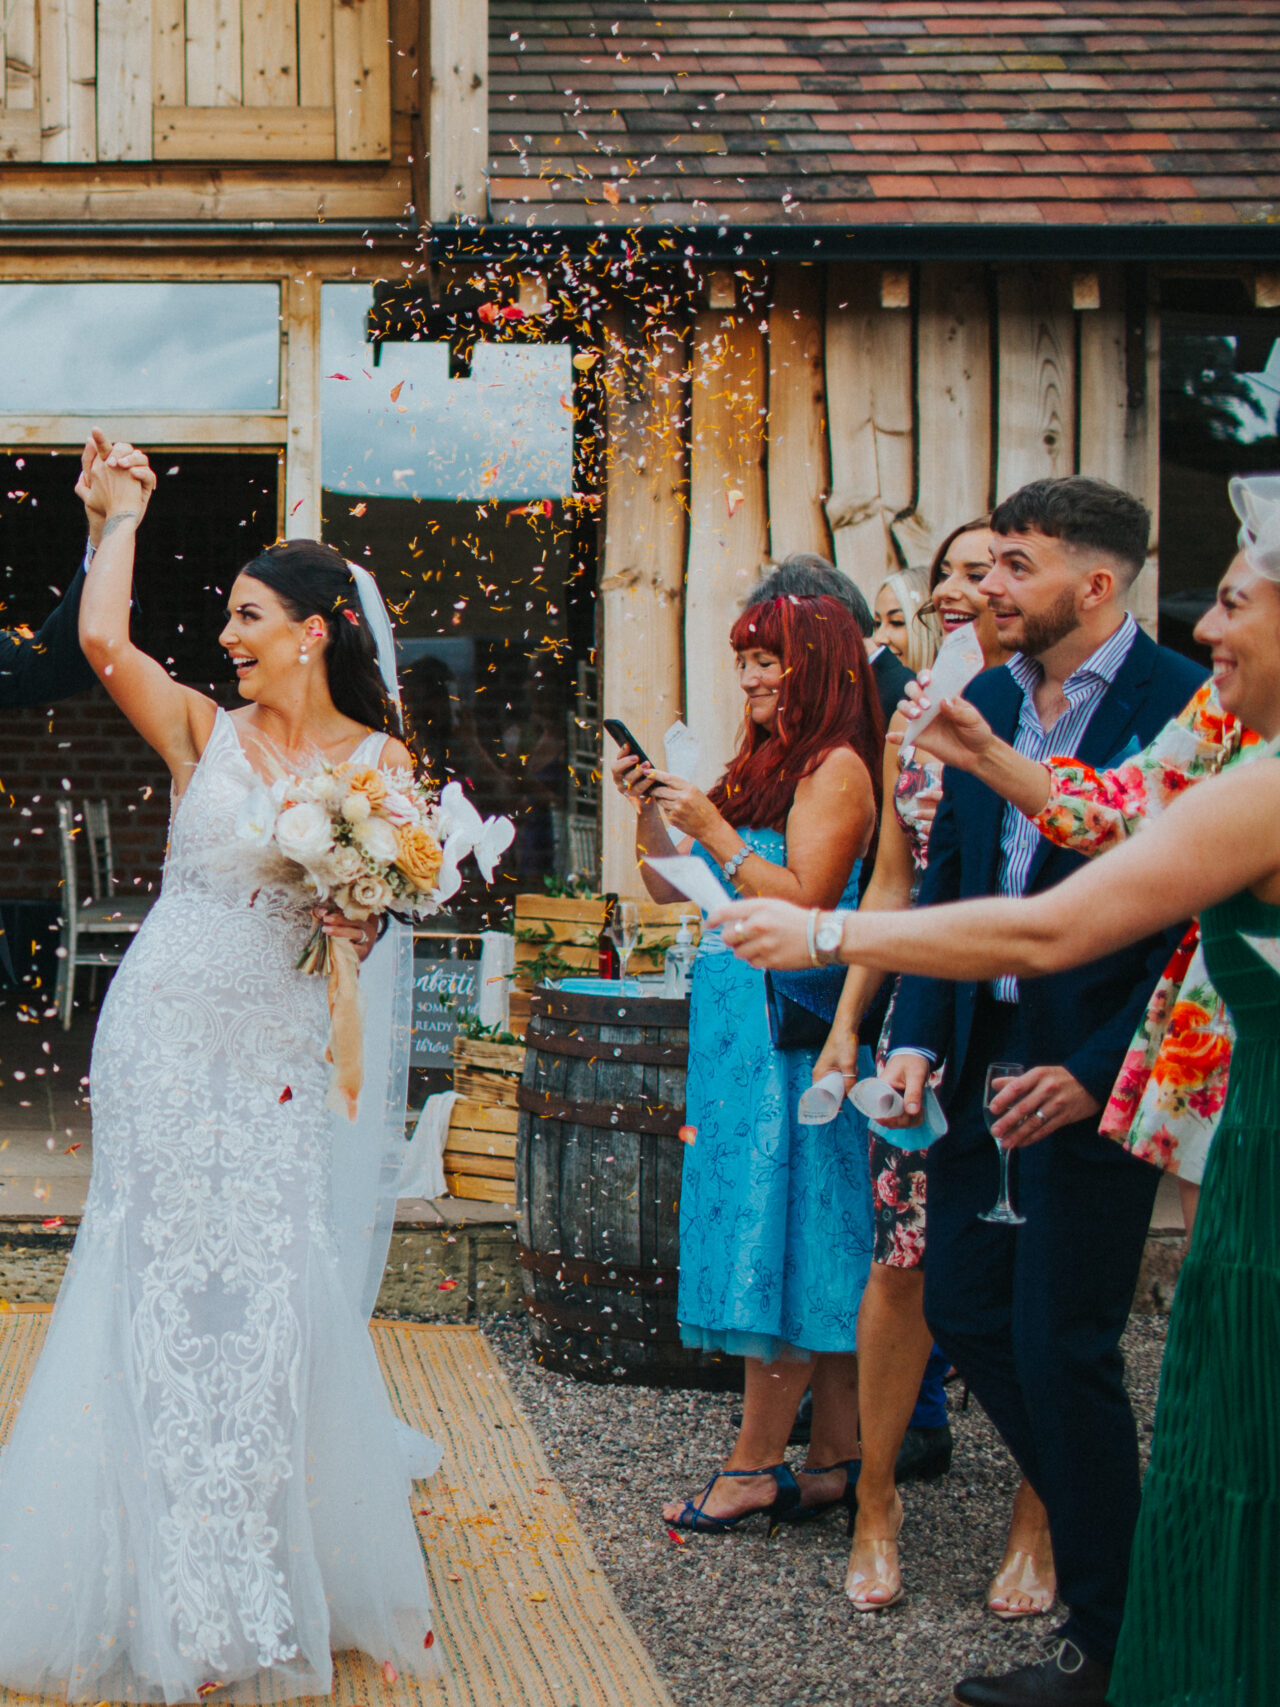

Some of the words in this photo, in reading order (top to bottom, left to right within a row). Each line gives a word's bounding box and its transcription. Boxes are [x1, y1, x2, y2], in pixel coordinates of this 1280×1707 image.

[413, 968, 475, 996] nfetti
[415, 1020, 453, 1032] READY
[411, 1037, 449, 1054] throw
